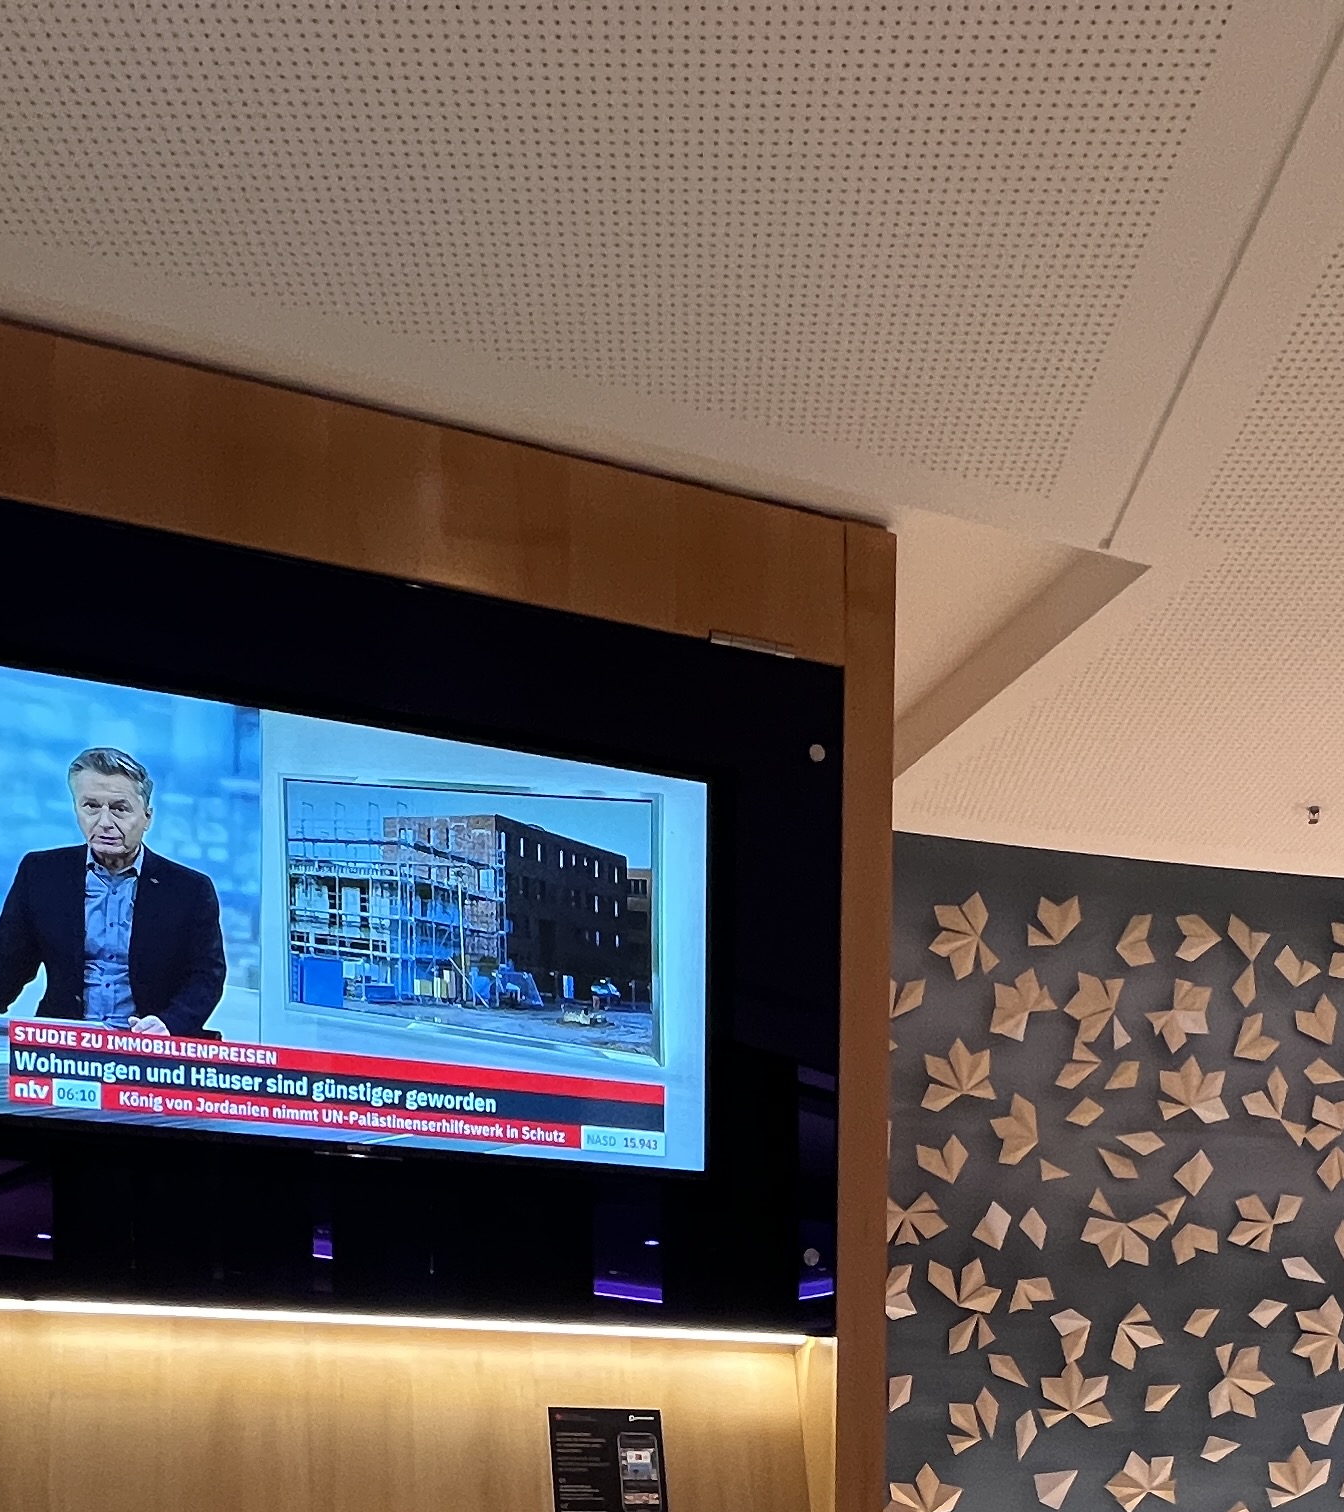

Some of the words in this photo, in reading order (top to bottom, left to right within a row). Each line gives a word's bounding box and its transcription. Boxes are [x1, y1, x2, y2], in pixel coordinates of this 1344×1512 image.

[14, 1026, 77, 1047] STUDIE
[81, 1033, 103, 1049] ZU
[107, 1035, 277, 1065] IMMOBILIENPREISEN
[14, 1050, 141, 1083] Wohnungen
[146, 1066, 185, 1086] und
[191, 1067, 262, 1092] Häuser
[266, 1074, 308, 1096] sind
[312, 1078, 402, 1107] günstiger
[406, 1090, 497, 1113] geworden
[14, 1080, 49, 1099] ntv
[57, 1087, 97, 1102] 06:10
[119, 1091, 163, 1112] König
[165, 1097, 193, 1112] von
[196, 1094, 269, 1118] Jordanien
[272, 1104, 319, 1122] nimmt
[322, 1109, 504, 1138] UN-Palästinenserhilfswerk
[506, 1125, 519, 1139] in
[521, 1126, 566, 1143] Schutz
[586, 1134, 617, 1147] NASD
[623, 1137, 658, 1150] 15.943
